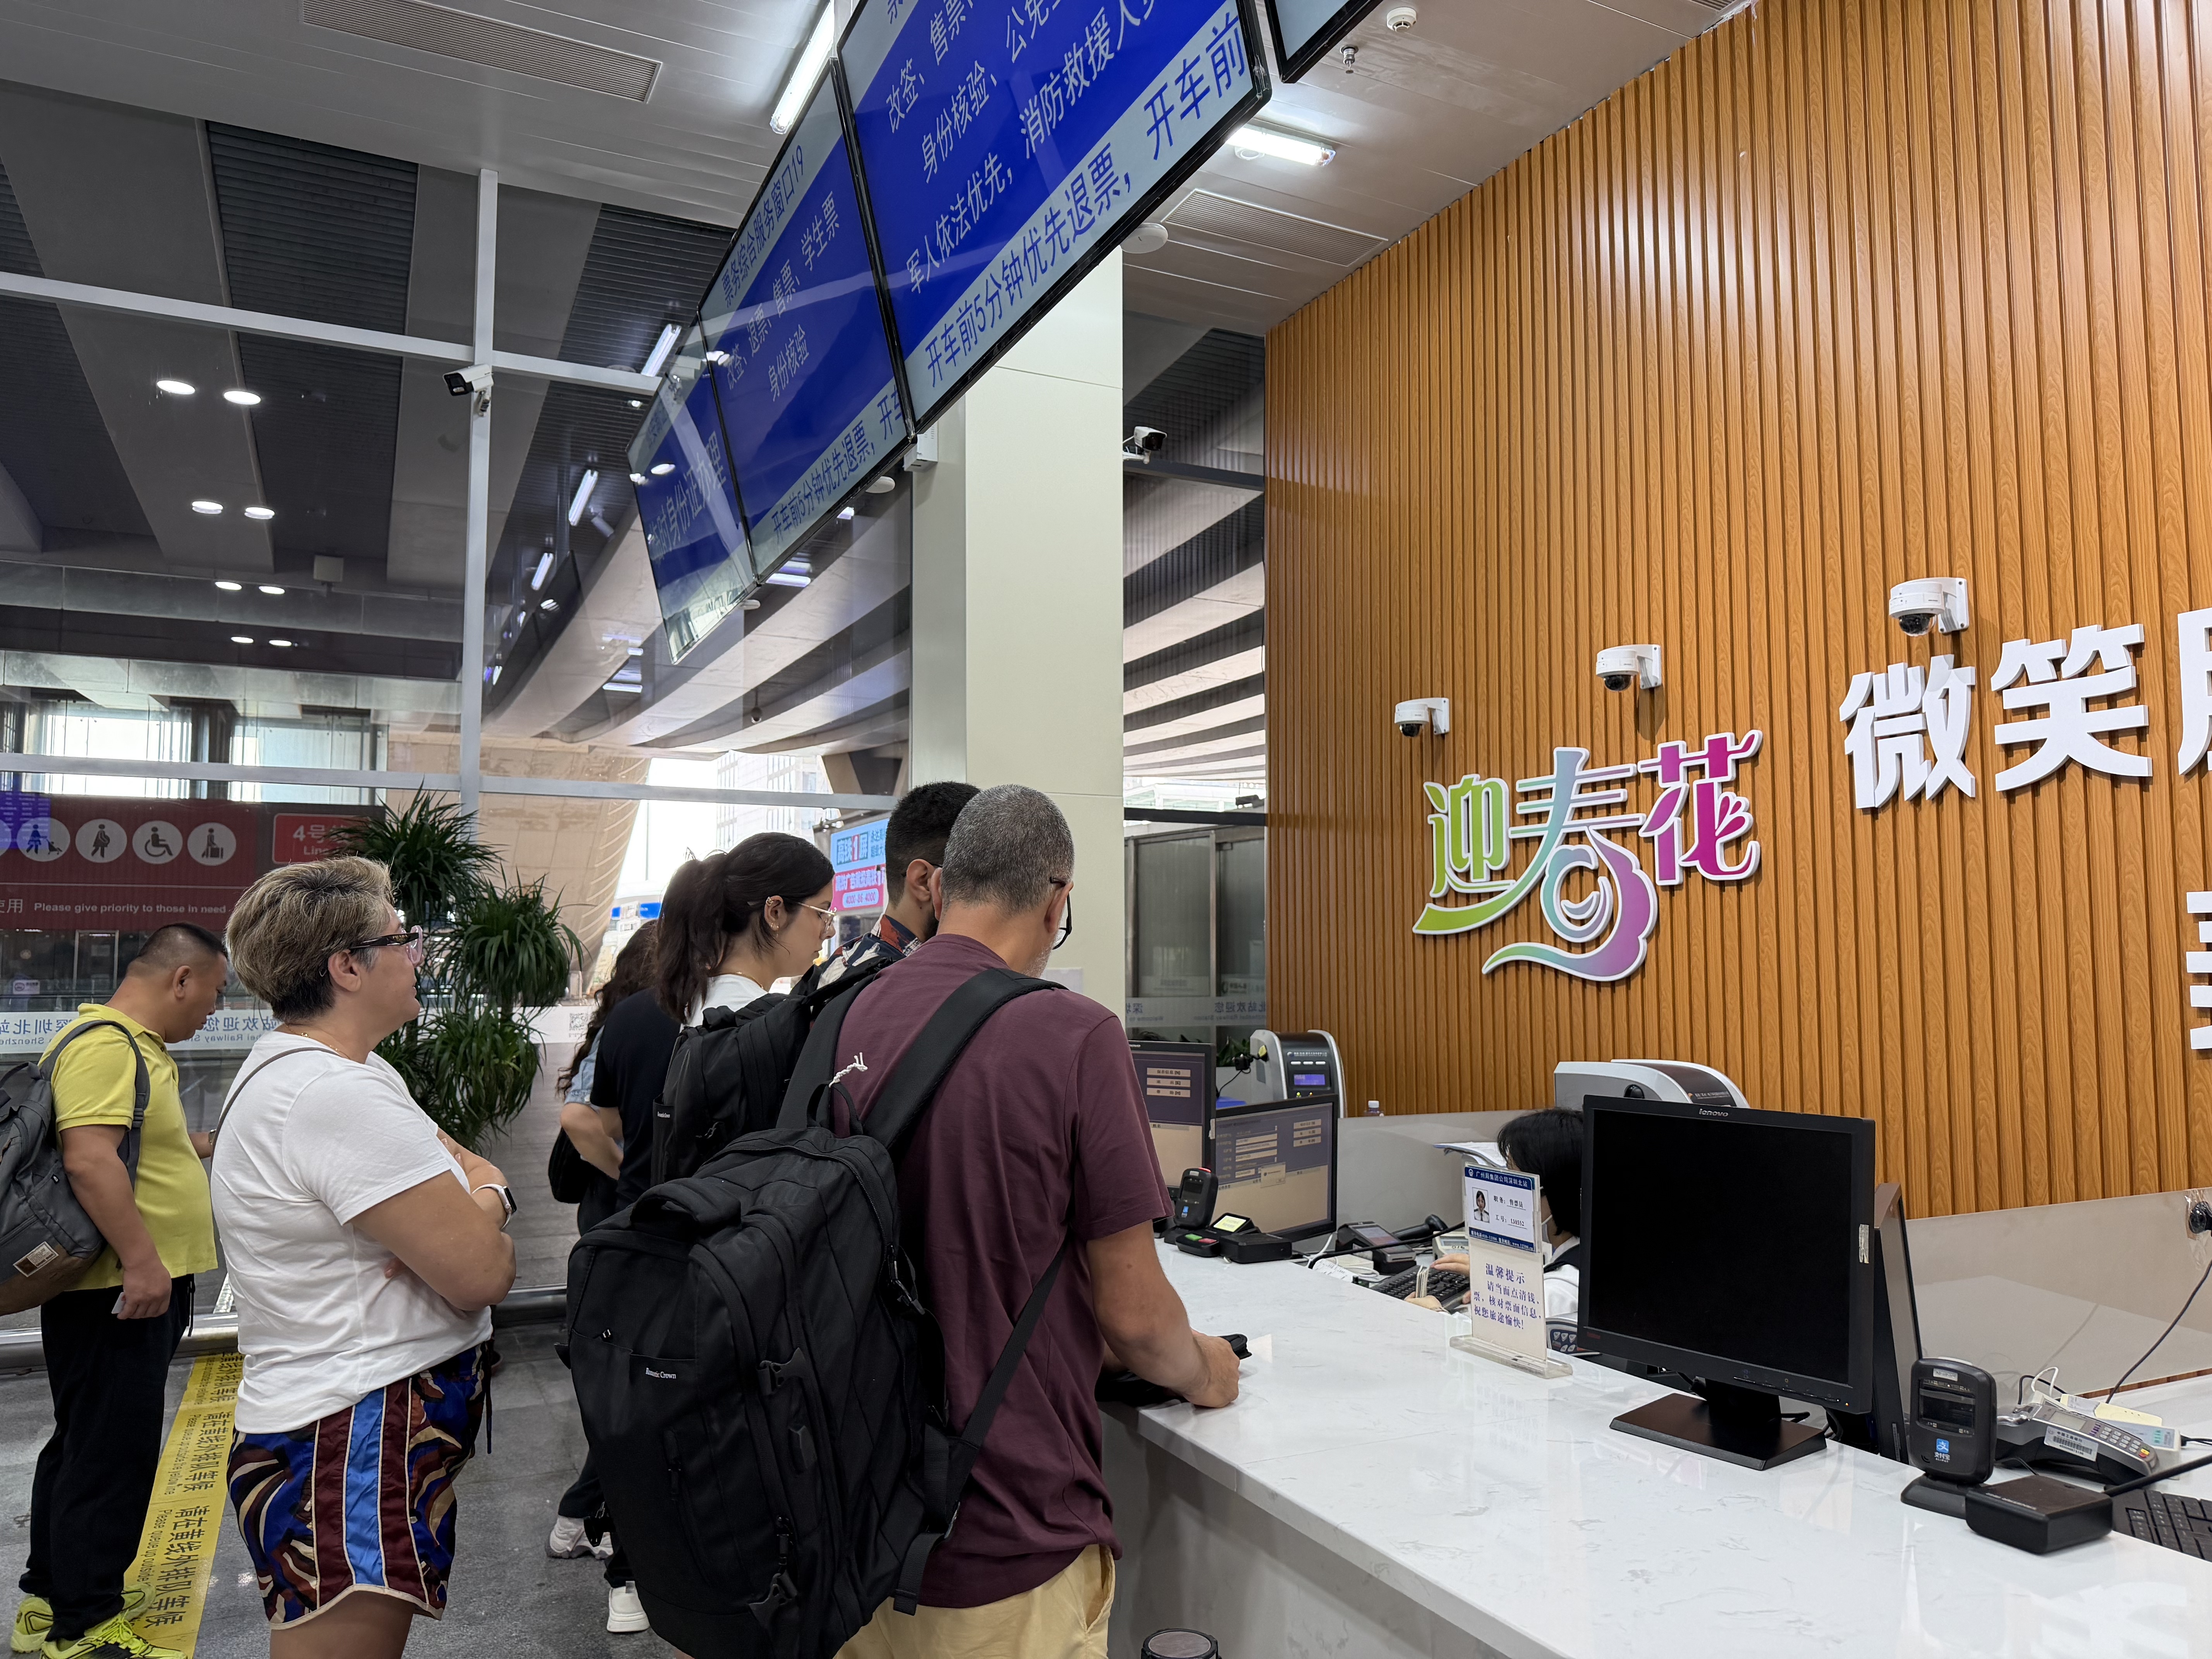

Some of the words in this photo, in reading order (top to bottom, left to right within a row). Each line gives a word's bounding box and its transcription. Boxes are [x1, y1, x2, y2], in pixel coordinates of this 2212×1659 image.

[768, 324, 809, 402] 身份核验
[1839, 608, 2212, 809] 微笑
[1412, 730, 1762, 982] 迎春花
[34, 903, 70, 912] Please
[75, 904, 97, 914] give
[100, 904, 139, 914] priority
[156, 905, 185, 913] those
[188, 905, 198, 913] in
[201, 905, 226, 914] need
[1699, 1108, 1729, 1116] lenovo
[1486, 1263, 1525, 1284] 温馨提示
[183, 1411, 232, 1492] 请在黄线外排队等候
[1934, 1451, 1950, 1460] 支付宝
[154, 1509, 173, 1529] Please
[147, 1530, 163, 1549] queue
[141, 1549, 157, 1558] up
[137, 1558, 156, 1582] outside
[143, 1505, 210, 1628] 请在黄线外排队等候
